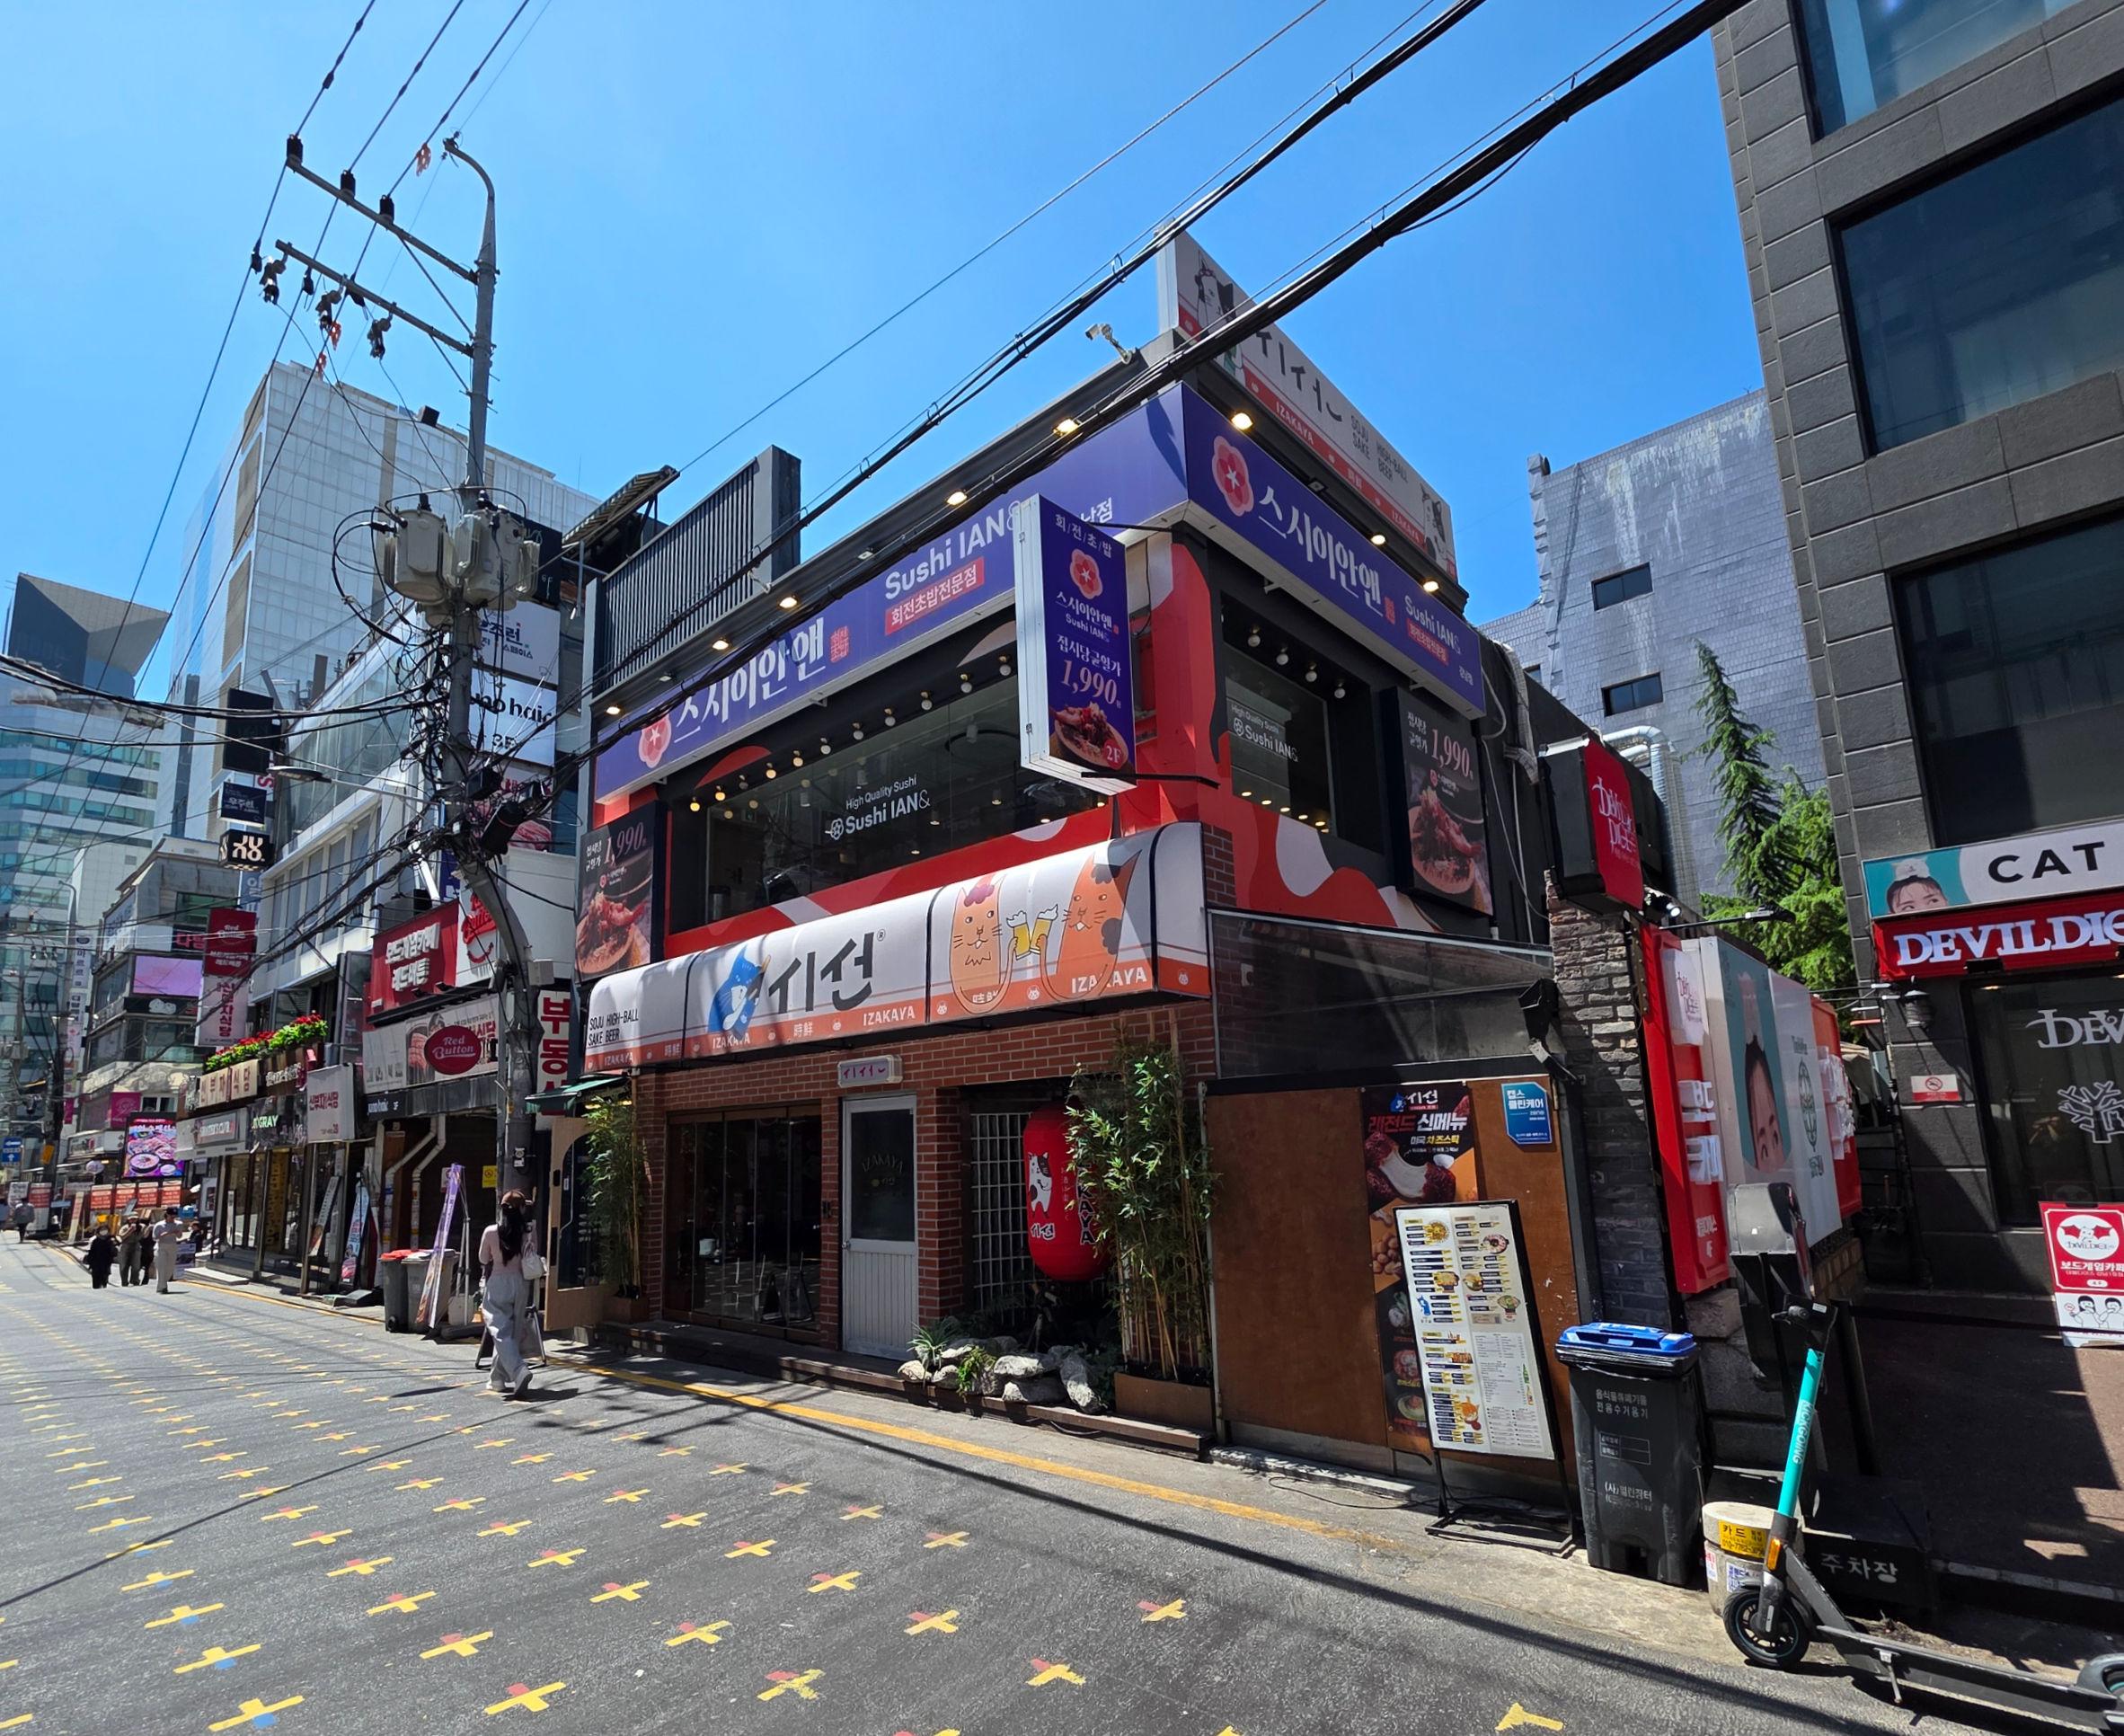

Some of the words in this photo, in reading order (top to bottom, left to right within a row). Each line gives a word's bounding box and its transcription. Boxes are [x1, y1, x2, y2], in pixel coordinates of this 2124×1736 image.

[1276, 402, 1314, 446] IZAKAYA
[1352, 433, 1371, 460] SAKE
[1258, 485, 1383, 618] 스시이안앤
[885, 538, 951, 599] Sushi
[891, 563, 977, 626] 회전초밥전문점
[1056, 591, 1113, 633] 스시이안앤
[1066, 613, 1089, 633] Sushi
[1404, 595, 1436, 634] Sushi
[674, 616, 826, 744] 스시이안앤
[509, 698, 553, 722] hair
[1231, 704, 1244, 718] High
[1264, 719, 1279, 735] Sushi
[1244, 726, 1273, 750] Sushi
[1105, 747, 1122, 764] 2F
[845, 795, 864, 810] High
[864, 785, 893, 803] Quality
[893, 774, 917, 792] Sushi
[845, 802, 887, 834] Sushi
[1987, 841, 2105, 883] CAT
[385, 923, 440, 964] 보드게임카페
[392, 958, 430, 991] 레드버튼
[589, 1013, 605, 1031] SOJU
[606, 1007, 639, 1026] HIGH-BALL
[863, 1005, 916, 1027] IZAKAYA
[432, 1045, 476, 1059] Button
[442, 1035, 465, 1046] Red
[588, 1032, 604, 1047] SAKE
[606, 1027, 621, 1043] BEER
[604, 1051, 634, 1067] IZAKAYA
[1367, 1114, 1416, 1134] 레전드
[1417, 1112, 1468, 1131] 신메뉴
[862, 1153, 903, 1174] IZAKAYA
[1792, 1398, 1813, 1466] KICKGOING
[1722, 1525, 1747, 1538] 카드
[1820, 1552, 1898, 1584] 주차장
